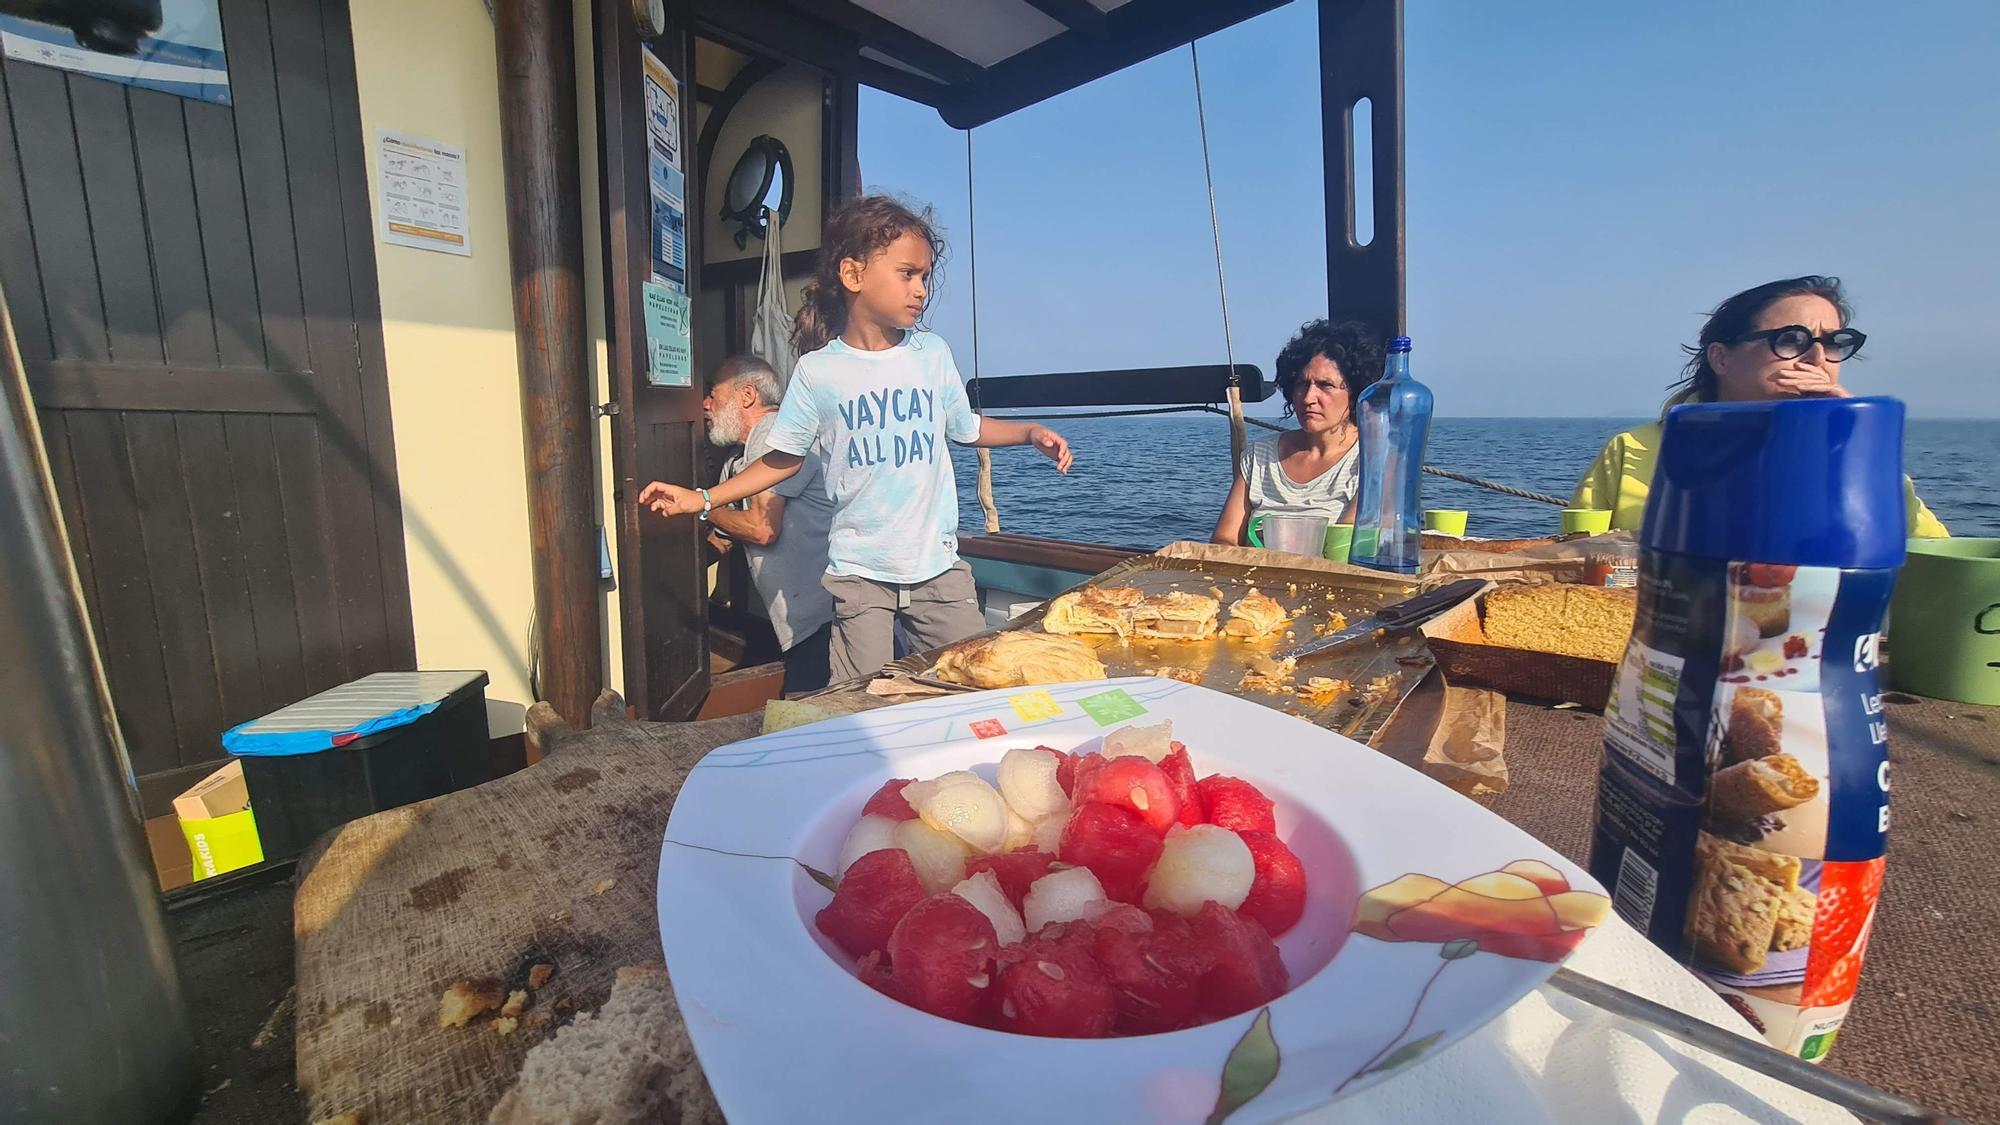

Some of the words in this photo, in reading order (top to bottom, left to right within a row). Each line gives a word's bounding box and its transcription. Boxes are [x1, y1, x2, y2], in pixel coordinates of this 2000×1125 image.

[838, 387, 933, 431] VAYCAY
[848, 435, 886, 469] ALL
[894, 430, 935, 468] DAY
